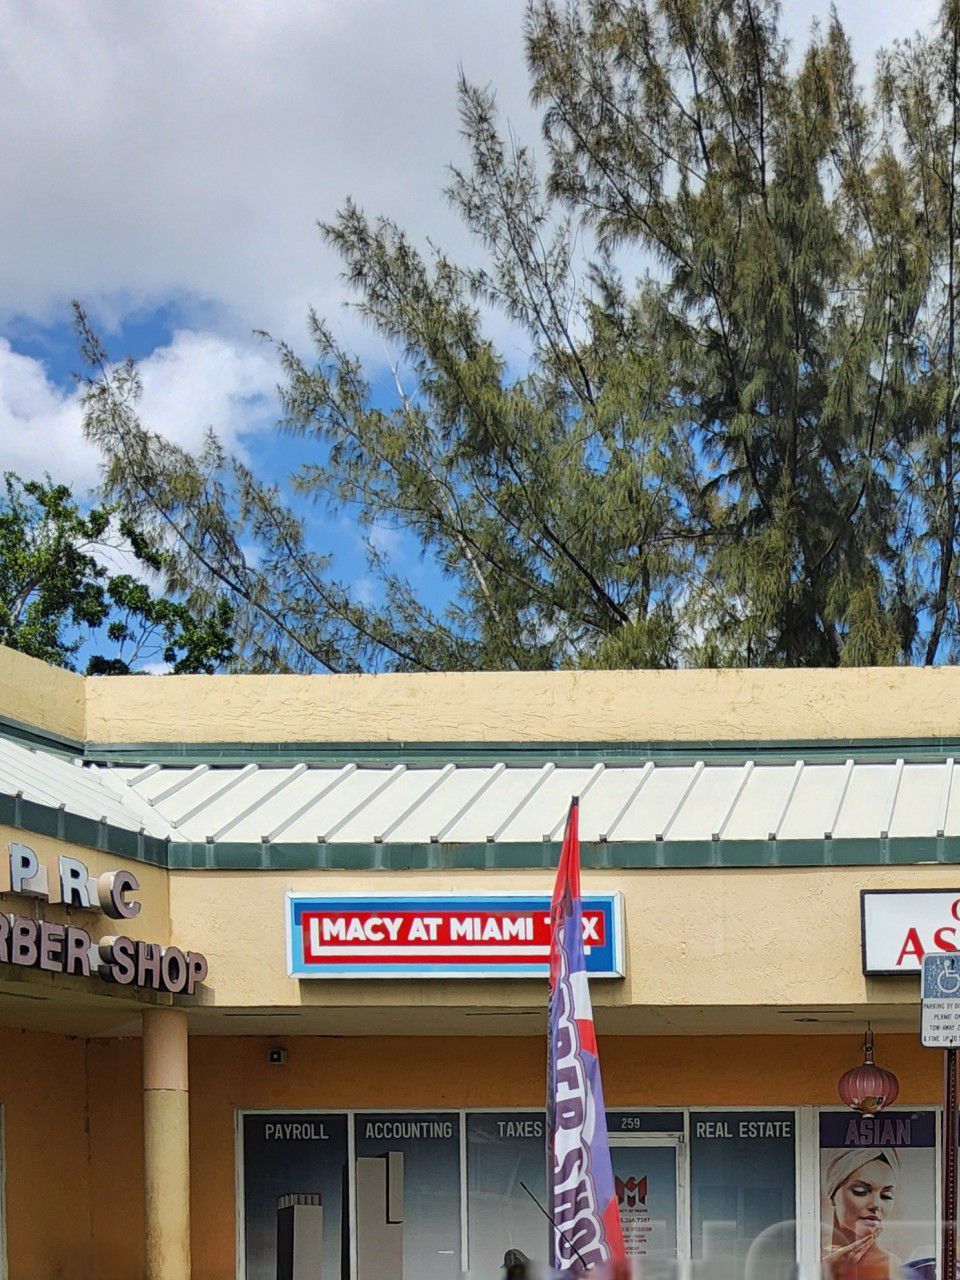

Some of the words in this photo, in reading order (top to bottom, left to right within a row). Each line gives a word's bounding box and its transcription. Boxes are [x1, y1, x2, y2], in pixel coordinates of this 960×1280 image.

[322, 917, 403, 942] MACY
[407, 917, 443, 941] AT
[450, 917, 534, 941] MIAMI
[107, 935, 208, 995] SHOP
[265, 1123, 330, 1140] PAYROLL
[365, 1122, 453, 1139] ACCOUNTING
[497, 1121, 543, 1138] TAXES
[696, 1122, 733, 1139] REAL
[739, 1121, 792, 1138] ESTATE
[621, 1117, 641, 1130] 259
[844, 1118, 912, 1145] ASIAN
